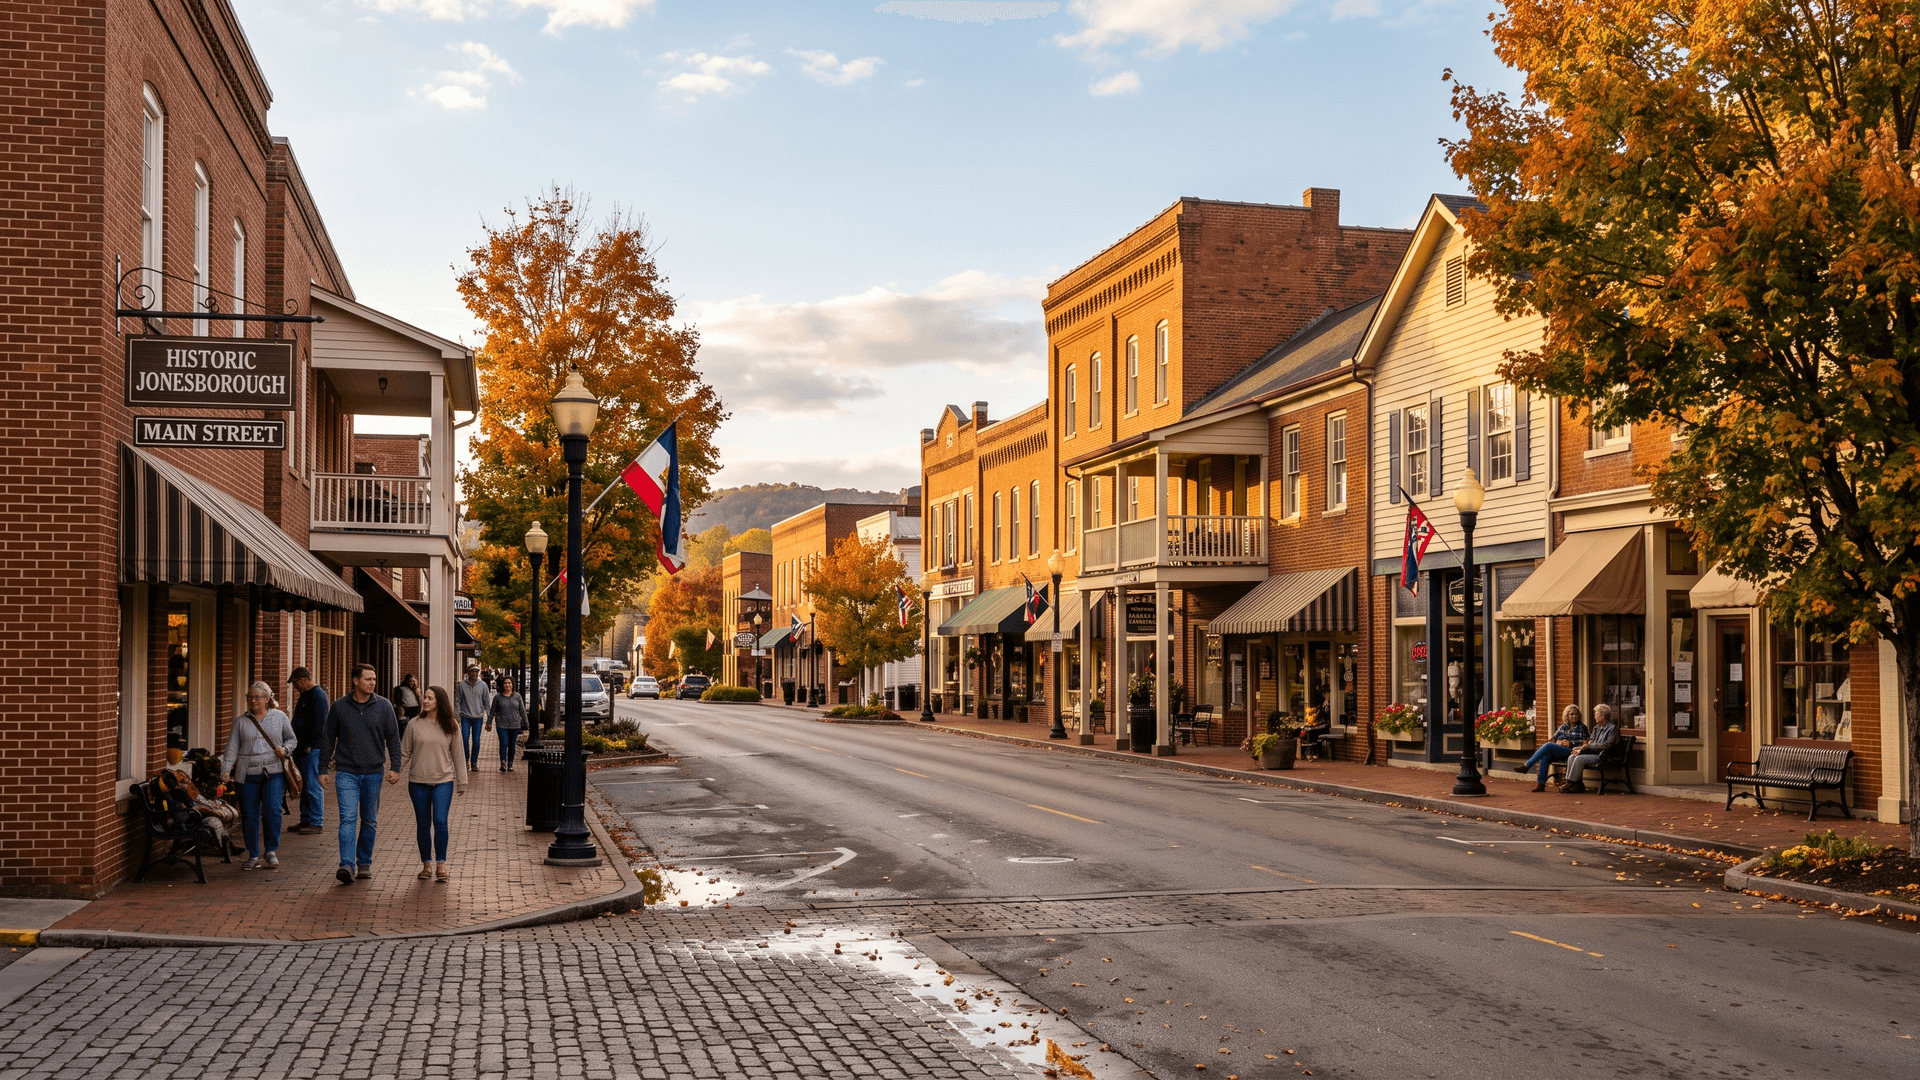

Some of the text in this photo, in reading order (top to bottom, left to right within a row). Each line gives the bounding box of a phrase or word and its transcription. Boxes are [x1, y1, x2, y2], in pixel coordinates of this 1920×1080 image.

[166, 349, 257, 370] HISTORIC
[136, 371, 286, 395] JONESBOROUGH
[143, 423, 278, 443] MAIN STREET
